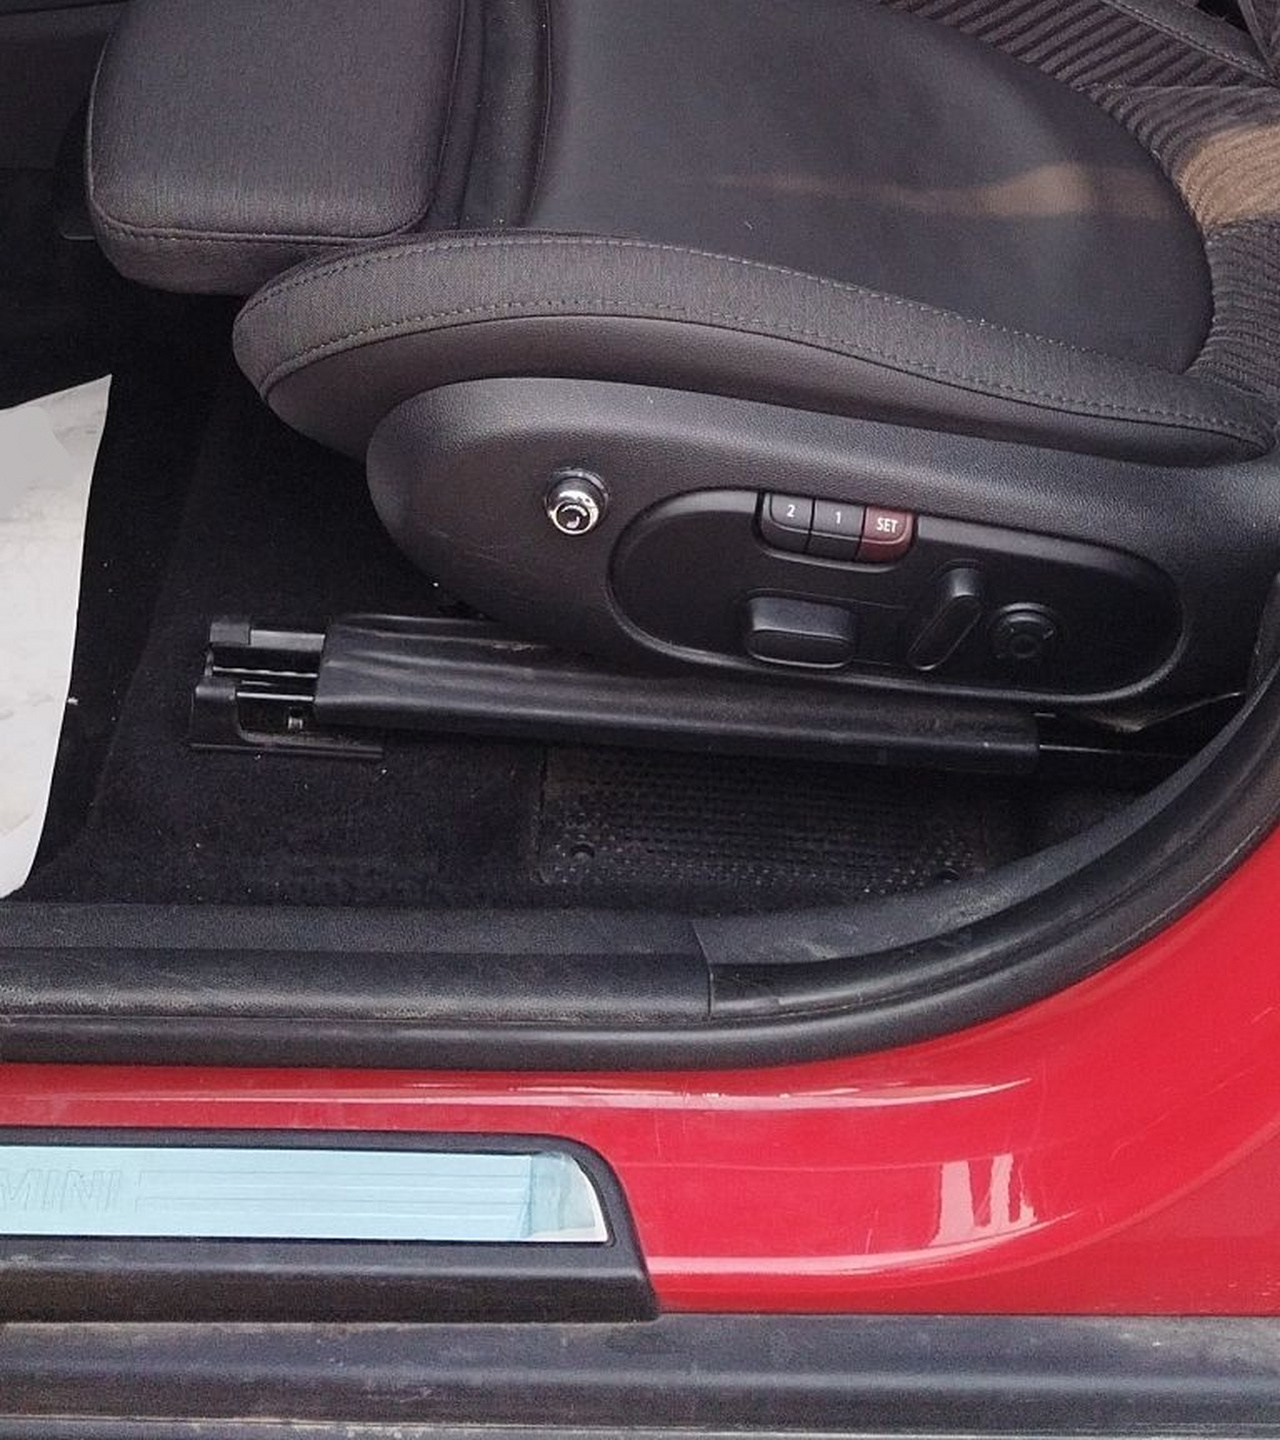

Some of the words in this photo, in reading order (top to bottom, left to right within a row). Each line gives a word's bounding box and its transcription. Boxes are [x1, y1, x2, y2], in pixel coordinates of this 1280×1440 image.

[786, 503, 796, 518] 2
[835, 510, 842, 525] 1
[876, 516, 899, 534] SET
